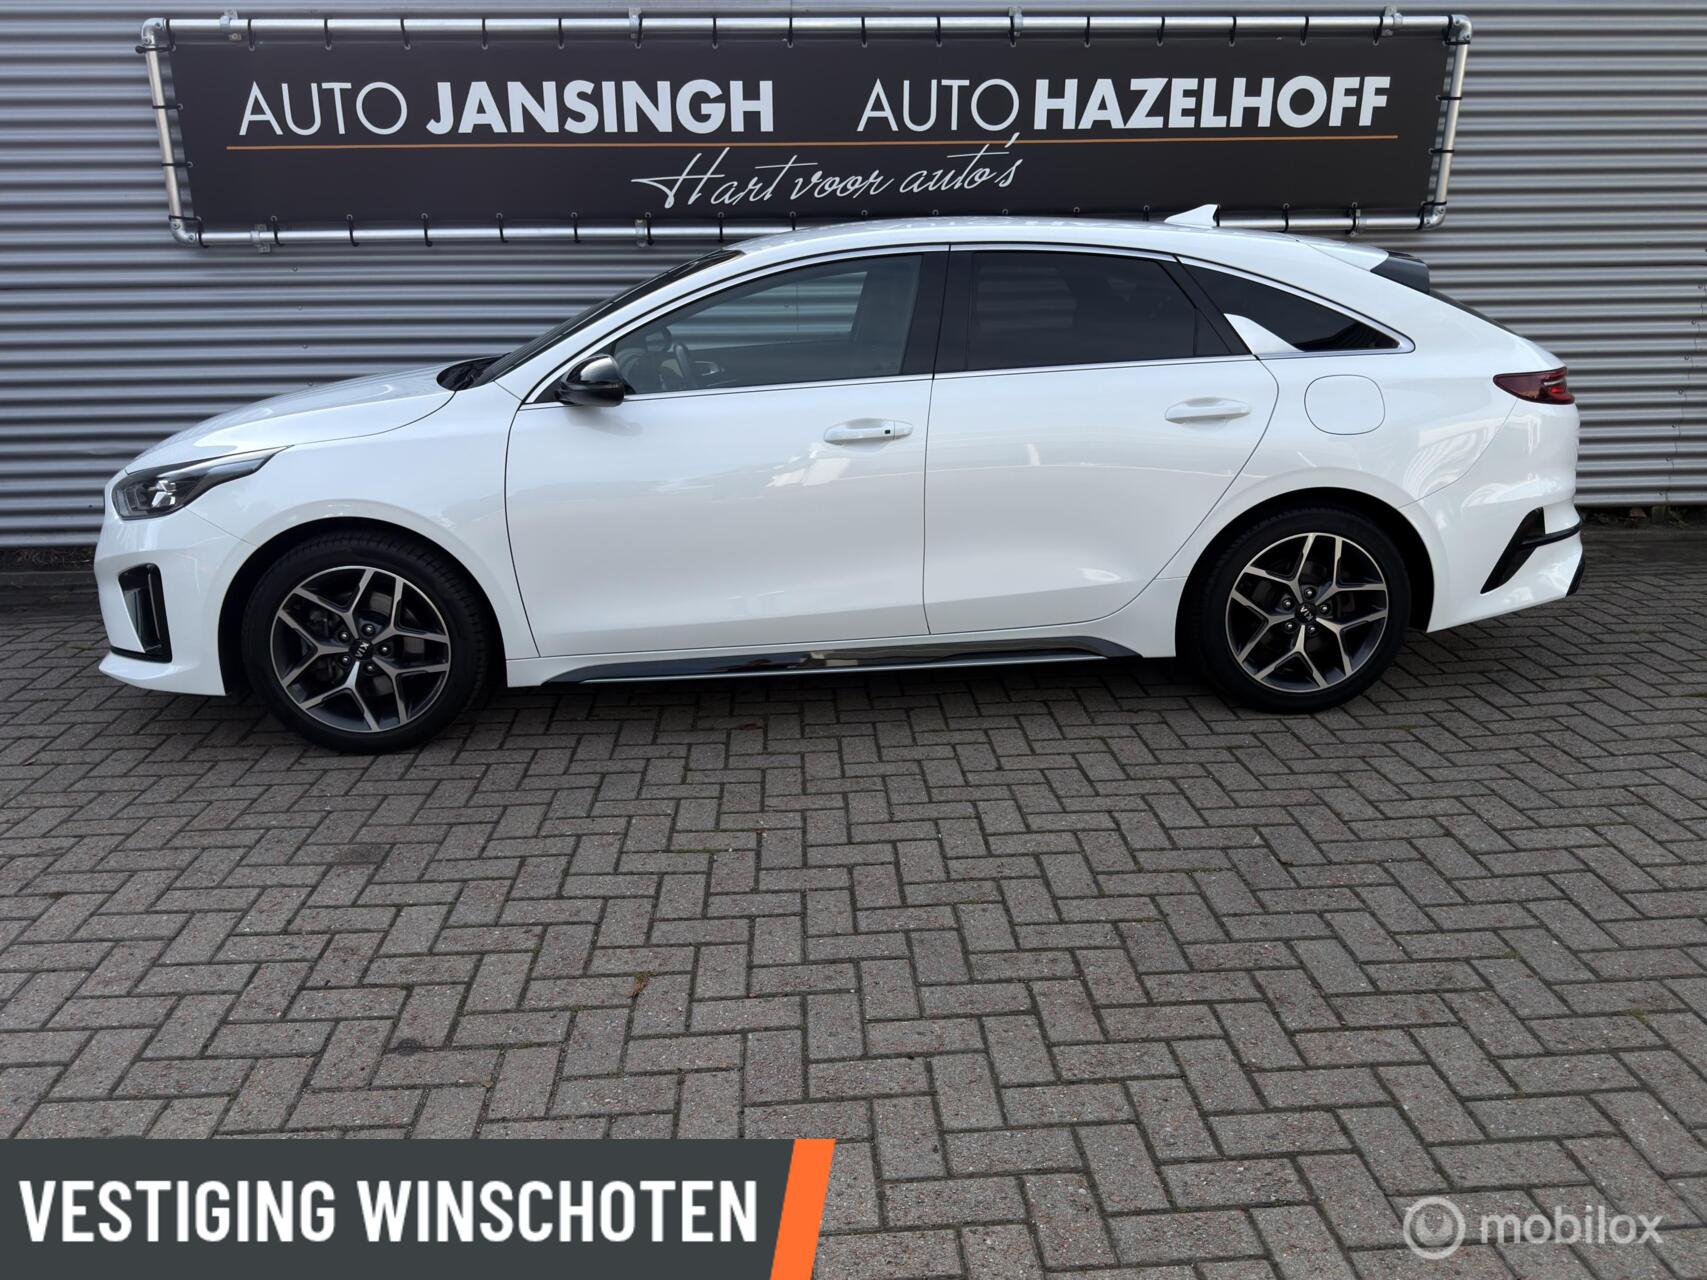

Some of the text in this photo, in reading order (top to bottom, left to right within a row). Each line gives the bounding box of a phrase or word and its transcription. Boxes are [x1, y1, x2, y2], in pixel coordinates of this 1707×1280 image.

[239, 79, 774, 136] AUTO JANSINGH
[857, 76, 1391, 132] AUTO HAZELHOFF
[631, 132, 1024, 208] Hart voor auto's
